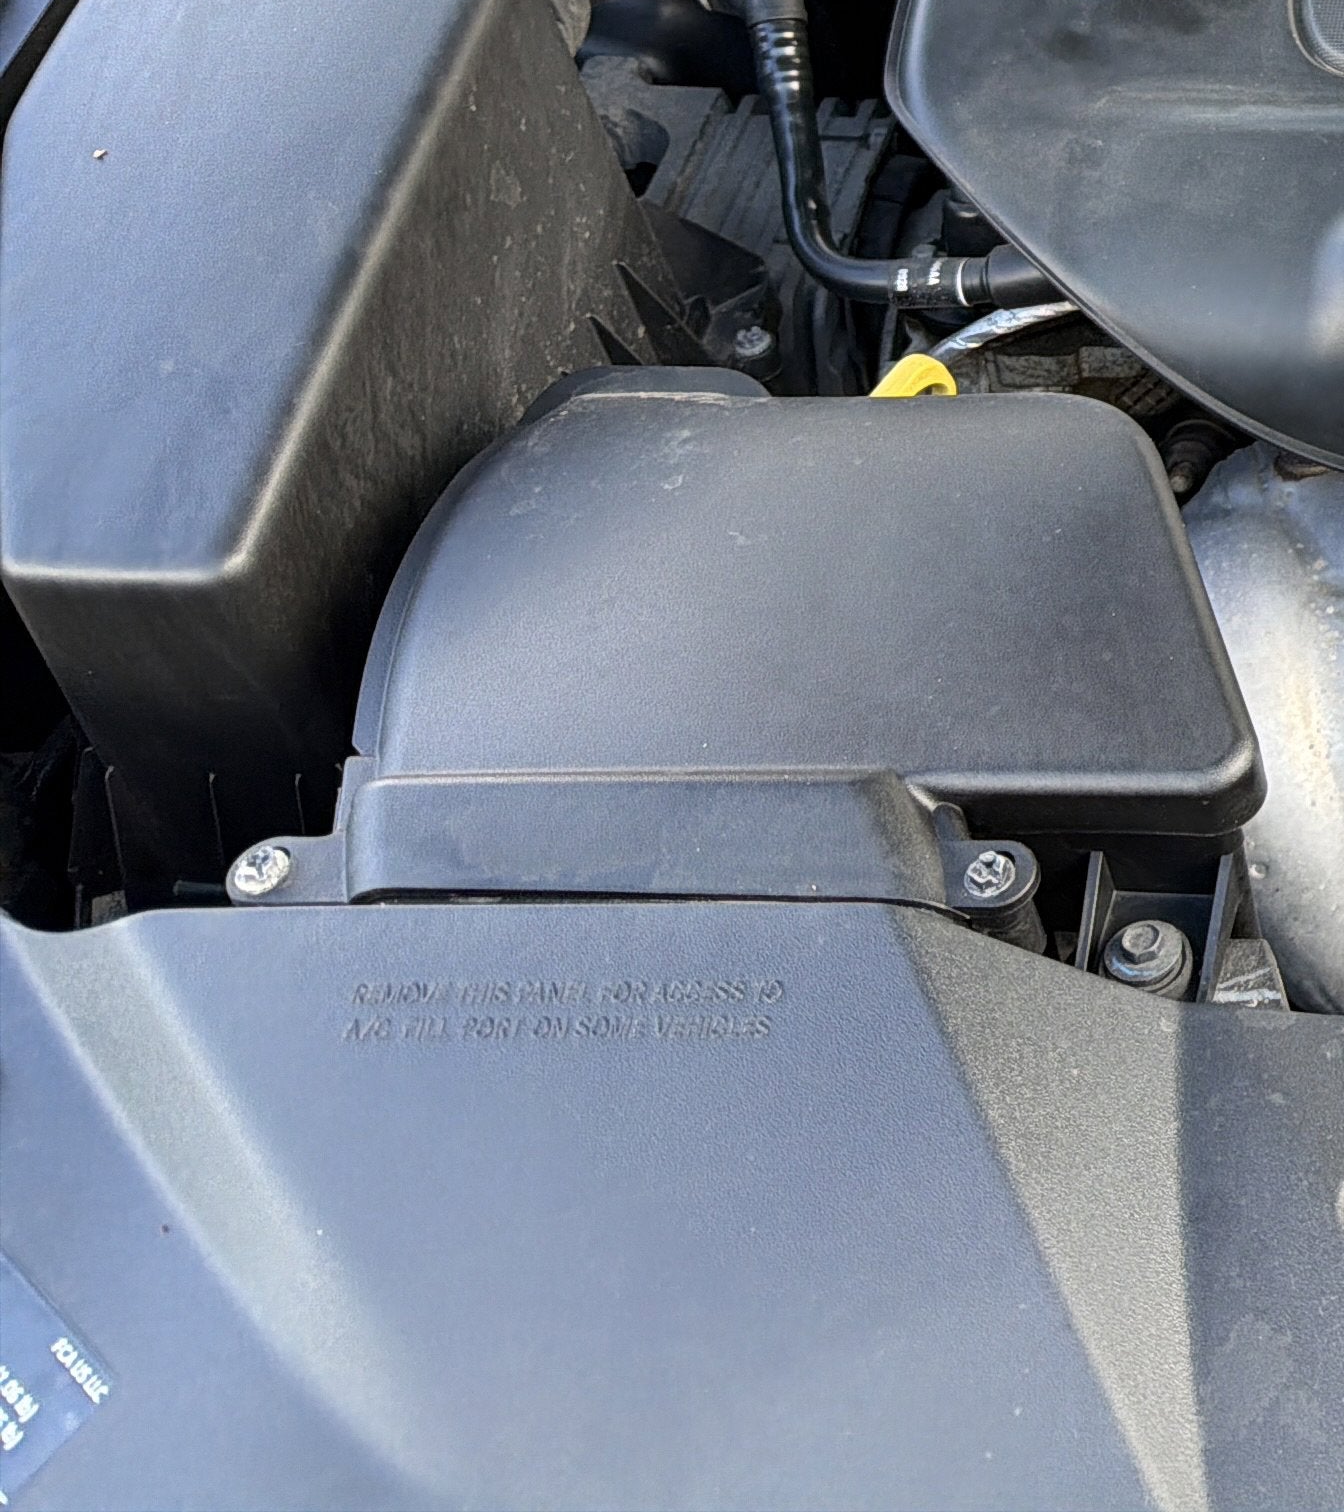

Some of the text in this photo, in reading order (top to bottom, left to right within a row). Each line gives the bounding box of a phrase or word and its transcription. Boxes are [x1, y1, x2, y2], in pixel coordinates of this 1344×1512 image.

[352, 978, 785, 1005] REMOVE THIS PANEL FOR ACCESS TO
[532, 1015, 570, 1039] ON
[573, 1015, 642, 1040] SOME
[654, 1014, 774, 1039] VEHICLES
